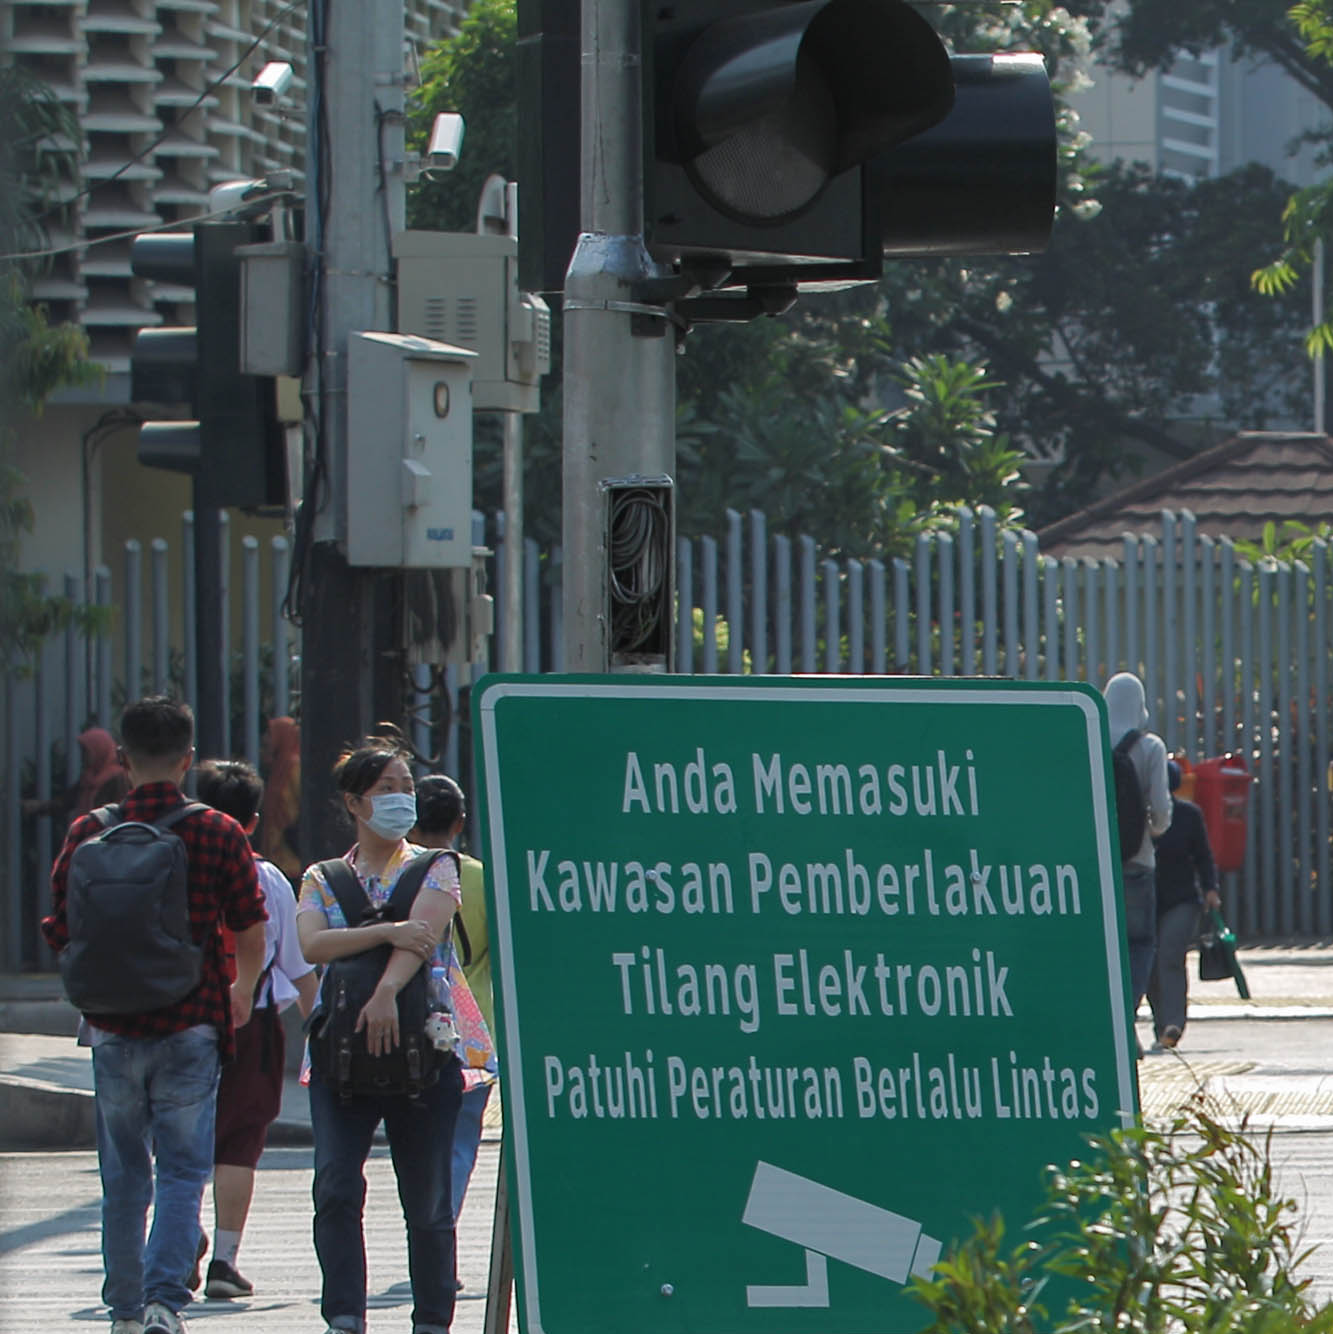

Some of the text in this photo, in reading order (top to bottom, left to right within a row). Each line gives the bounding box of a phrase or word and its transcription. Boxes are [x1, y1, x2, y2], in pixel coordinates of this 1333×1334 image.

[624, 748, 979, 817] Anda Memasuki
[528, 849, 1082, 917] Kawasan Pemberlakuan
[613, 946, 1014, 1034] Tilang Elektronik
[545, 1050, 1100, 1120] Patuhi Peraturan Berlalu Lintas
